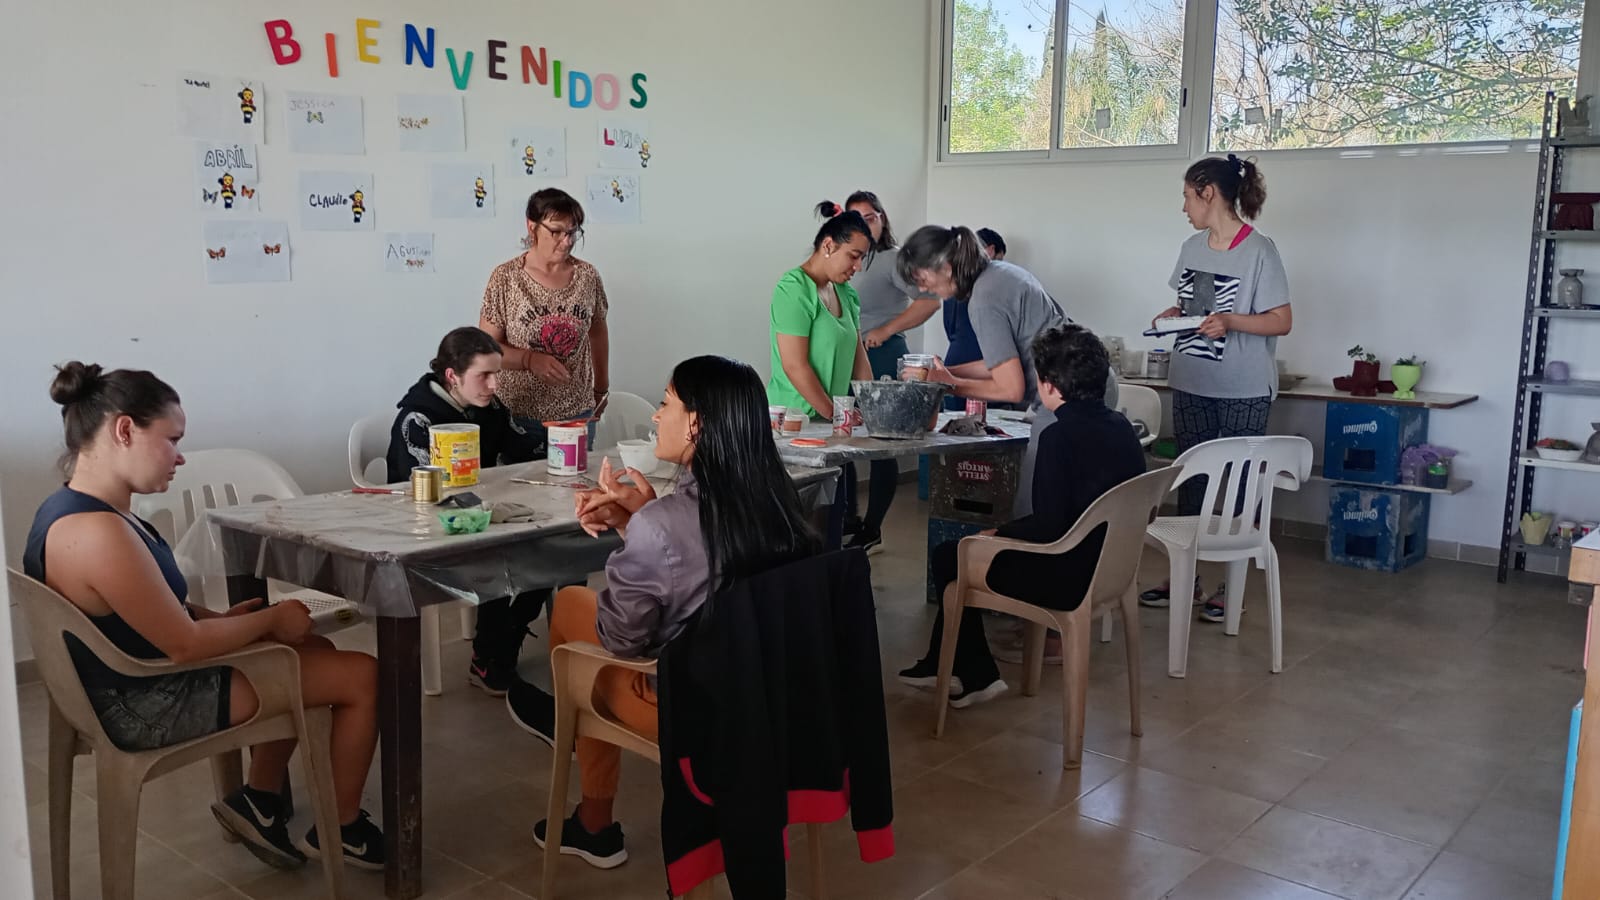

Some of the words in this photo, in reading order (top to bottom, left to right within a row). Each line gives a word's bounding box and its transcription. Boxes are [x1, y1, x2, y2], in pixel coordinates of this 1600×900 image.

[264, 18, 648, 108] BIENVENIDOS
[957, 461, 992, 472] ARTOIS
[957, 470, 990, 480] STELLA
